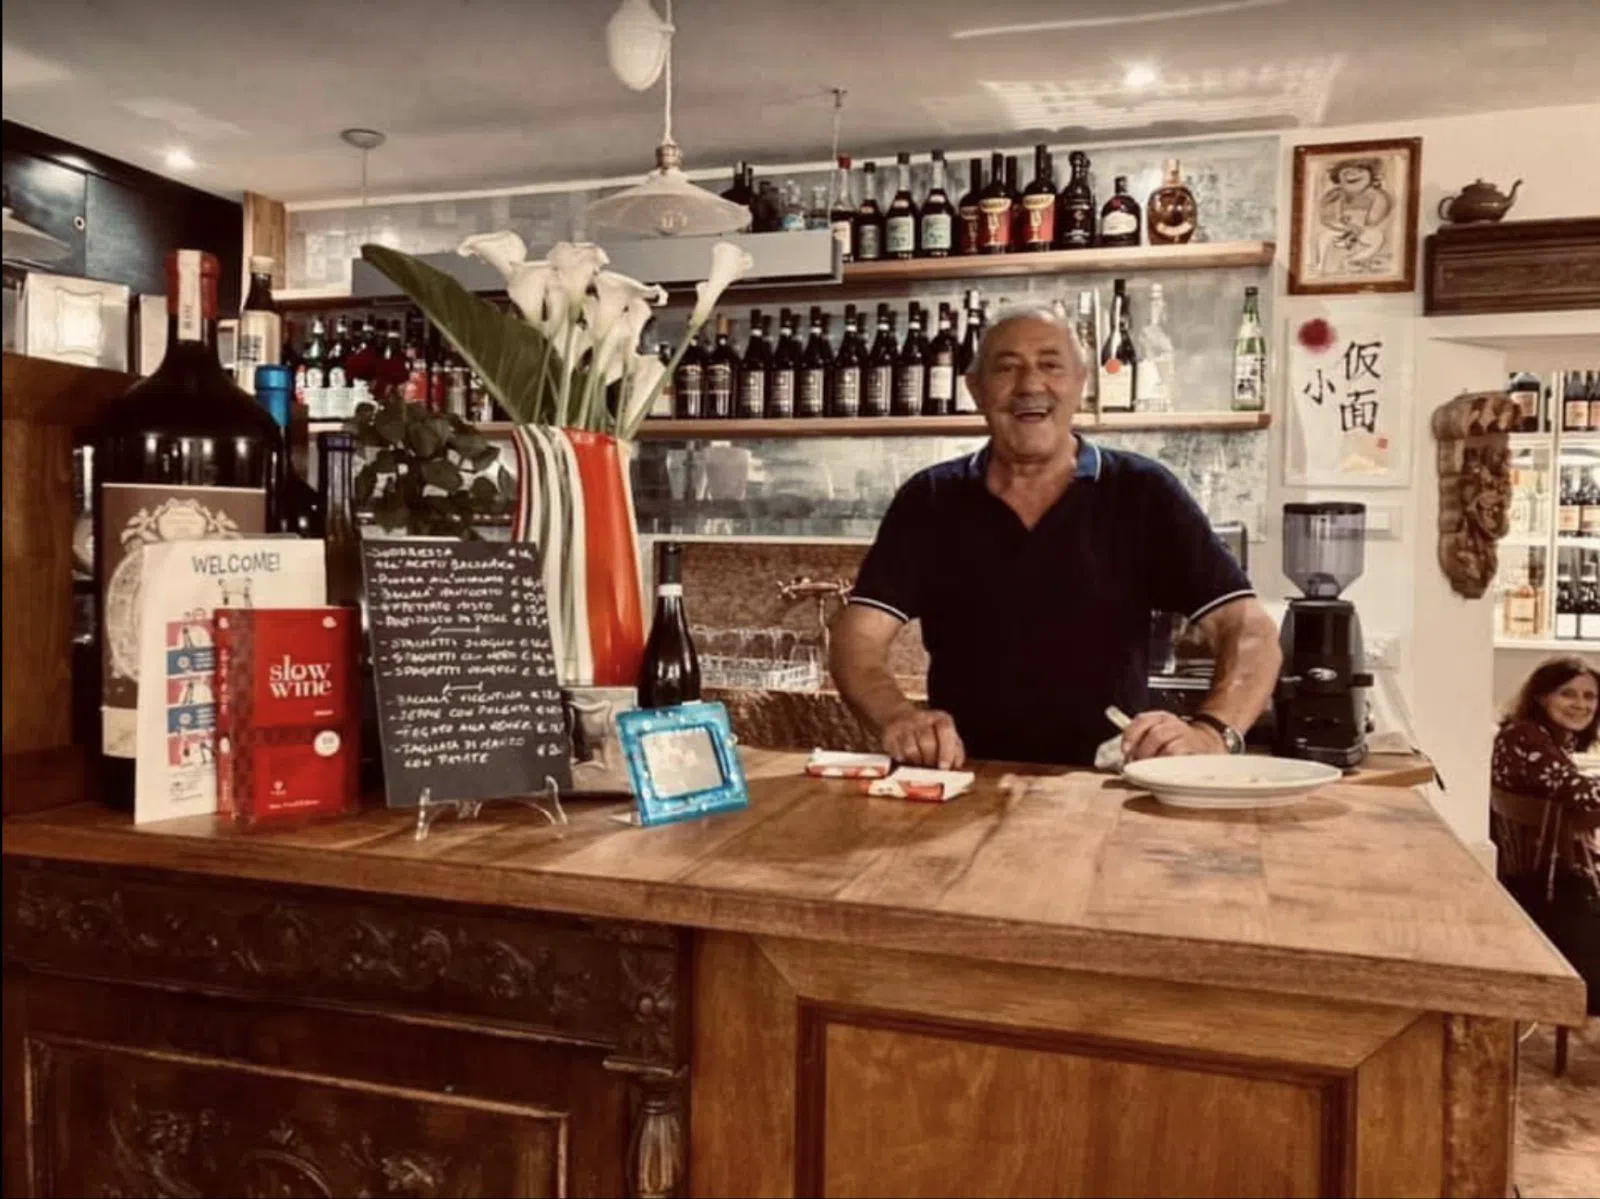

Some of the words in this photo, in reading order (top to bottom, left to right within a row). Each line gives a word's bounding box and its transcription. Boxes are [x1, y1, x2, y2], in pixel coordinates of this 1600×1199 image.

[1304, 369, 1335, 405] 小
[1340, 341, 1382, 433] 仮面
[191, 552, 281, 575] WELCOME!
[269, 654, 332, 681] slow
[269, 680, 332, 698] wine
